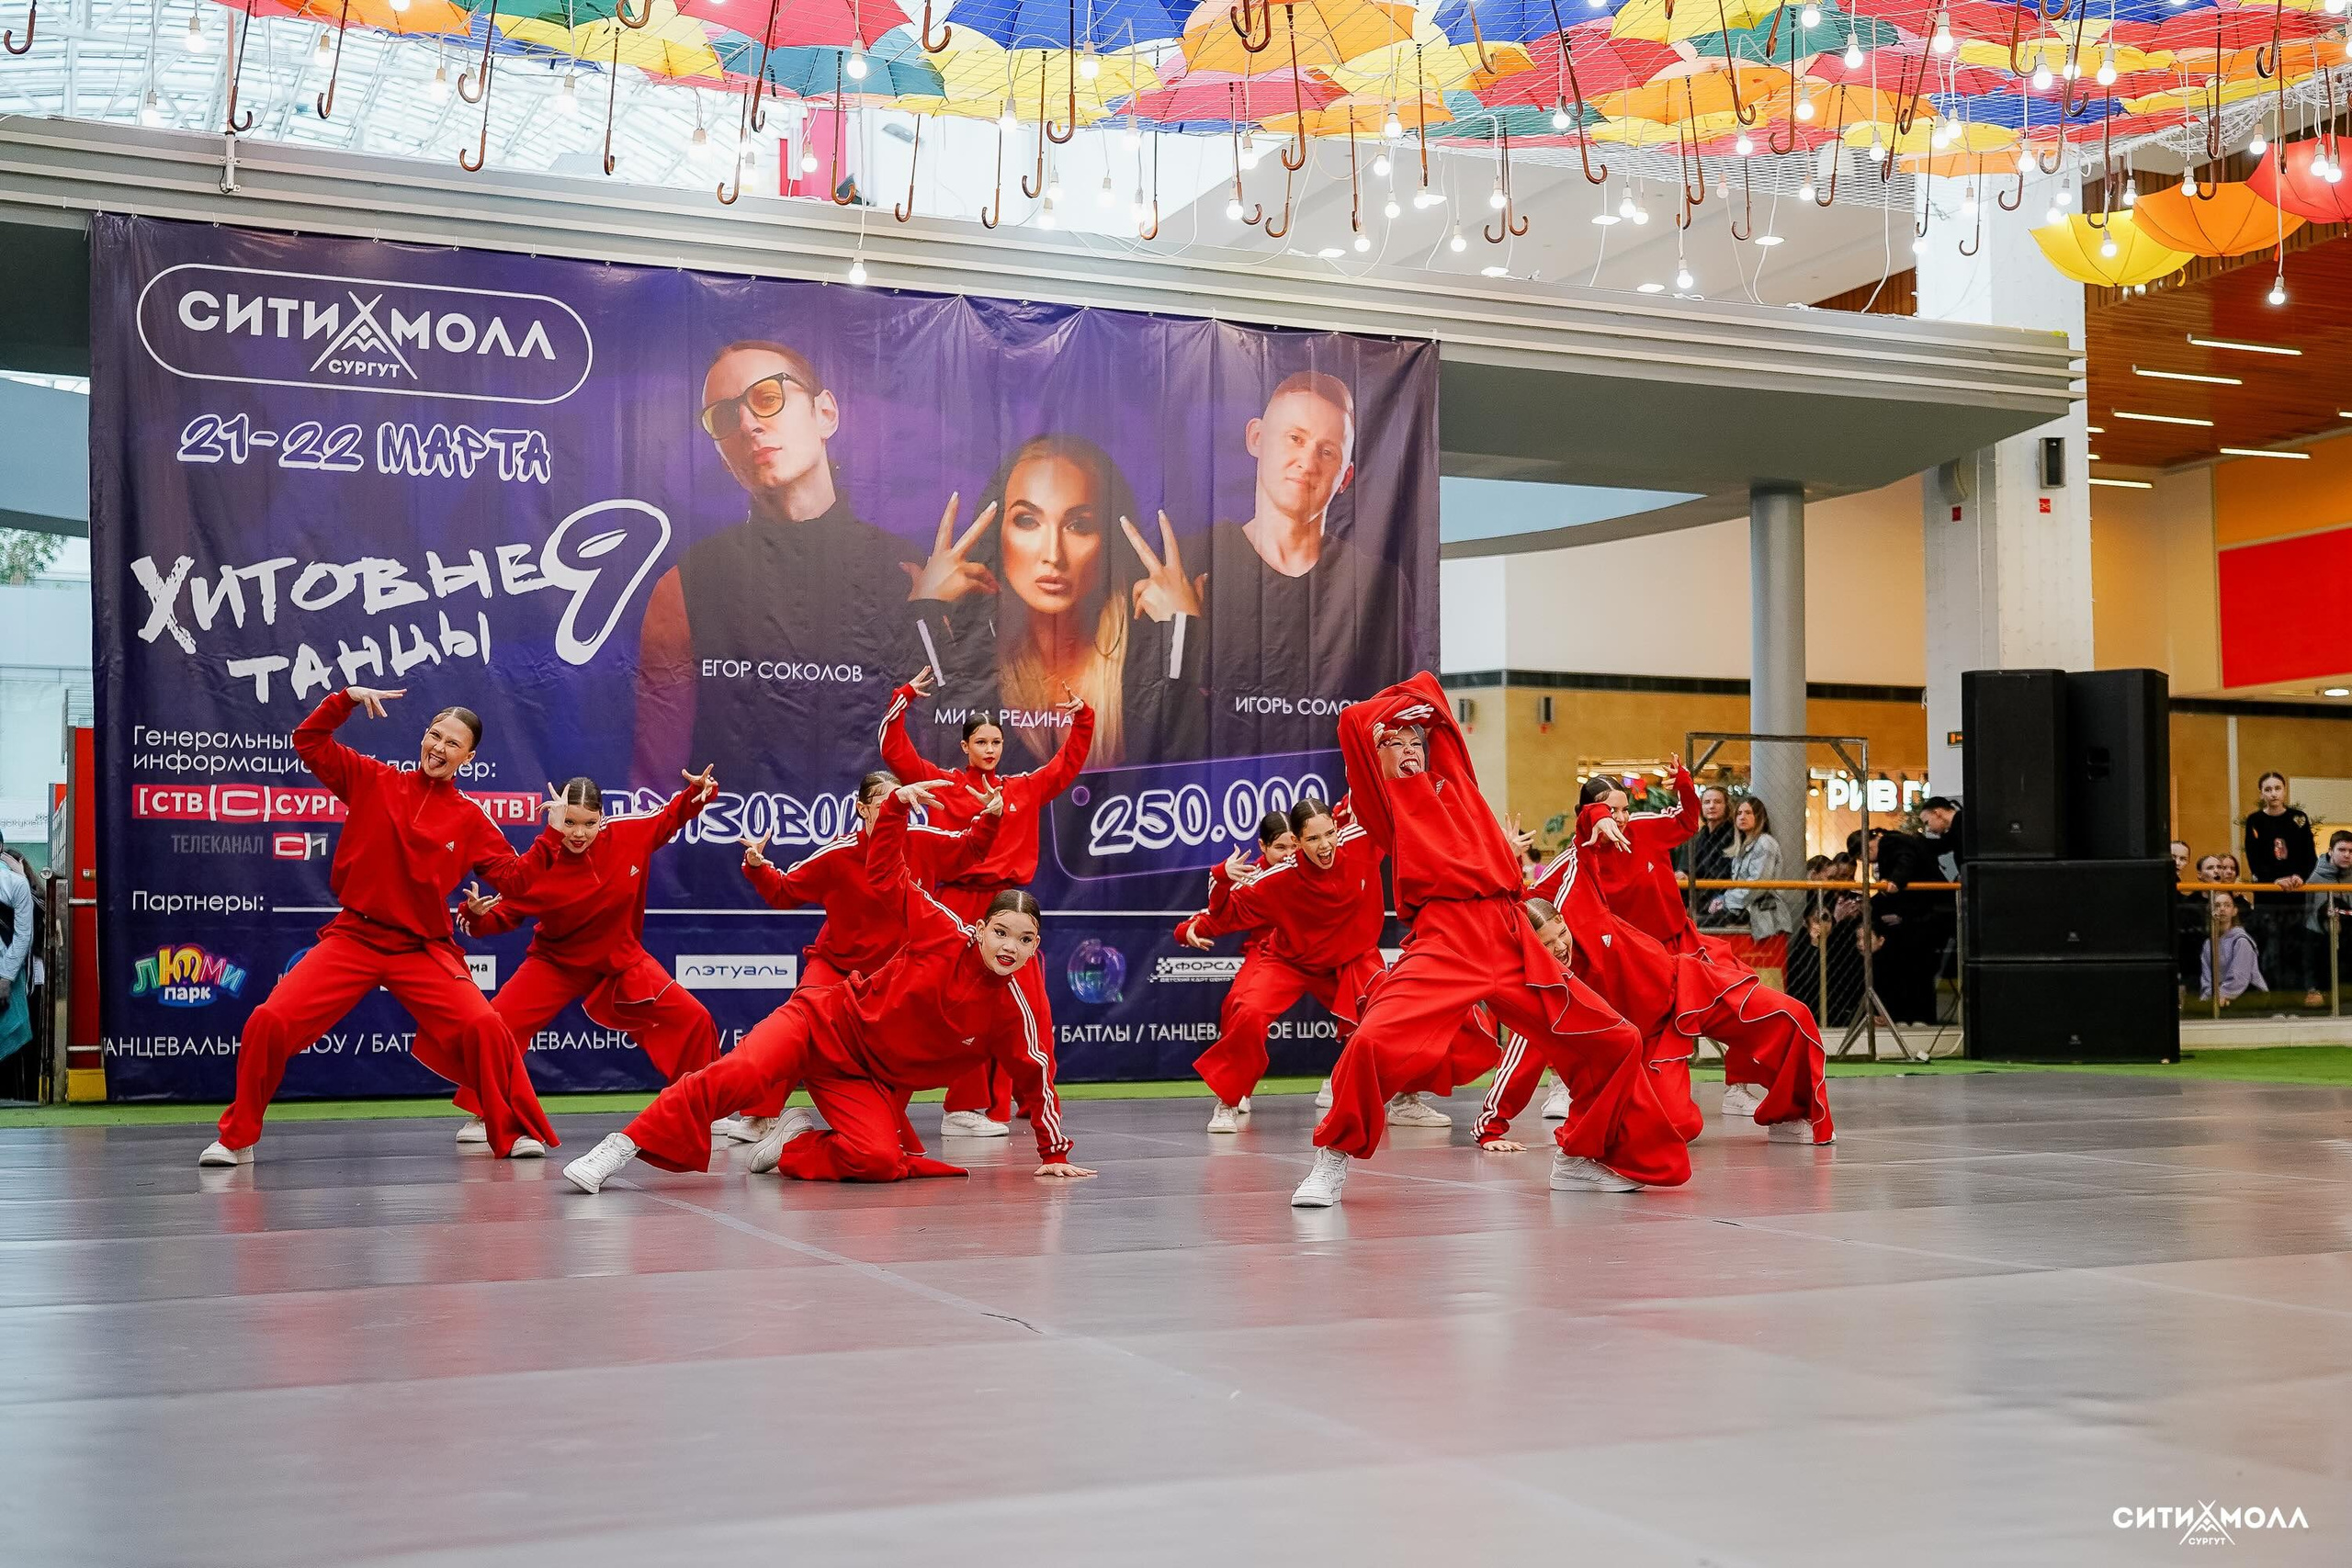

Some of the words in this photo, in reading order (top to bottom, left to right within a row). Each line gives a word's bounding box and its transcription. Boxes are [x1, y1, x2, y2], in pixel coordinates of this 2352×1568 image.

[177, 290, 339, 339] СИТИ
[390, 310, 556, 360] МОЛЛ
[328, 358, 401, 378] СУРГУТ
[176, 412, 365, 472] 21-22
[377, 421, 551, 484] МАРТА
[701, 659, 752, 678] ЕГОР
[757, 660, 864, 683] СОКОЛОВ
[1235, 695, 1294, 715] ИГОРЬ
[1296, 697, 1360, 716] СОЛО
[934, 707, 989, 725] МИ
[999, 708, 1073, 728] РЕДИНА
[133, 749, 311, 776] информацио
[1826, 778, 1898, 812] РИВ
[1088, 773, 1329, 857] 250.000
[171, 833, 264, 855] ТЕЛЕКАНАЛ
[132, 890, 265, 915] Партнеры:
[1174, 961, 1245, 972] ФОРСА
[164, 986, 211, 1003] парк
[1060, 1023, 1131, 1043] БАТТЛЫ
[1296, 1021, 1339, 1040] ШОУ
